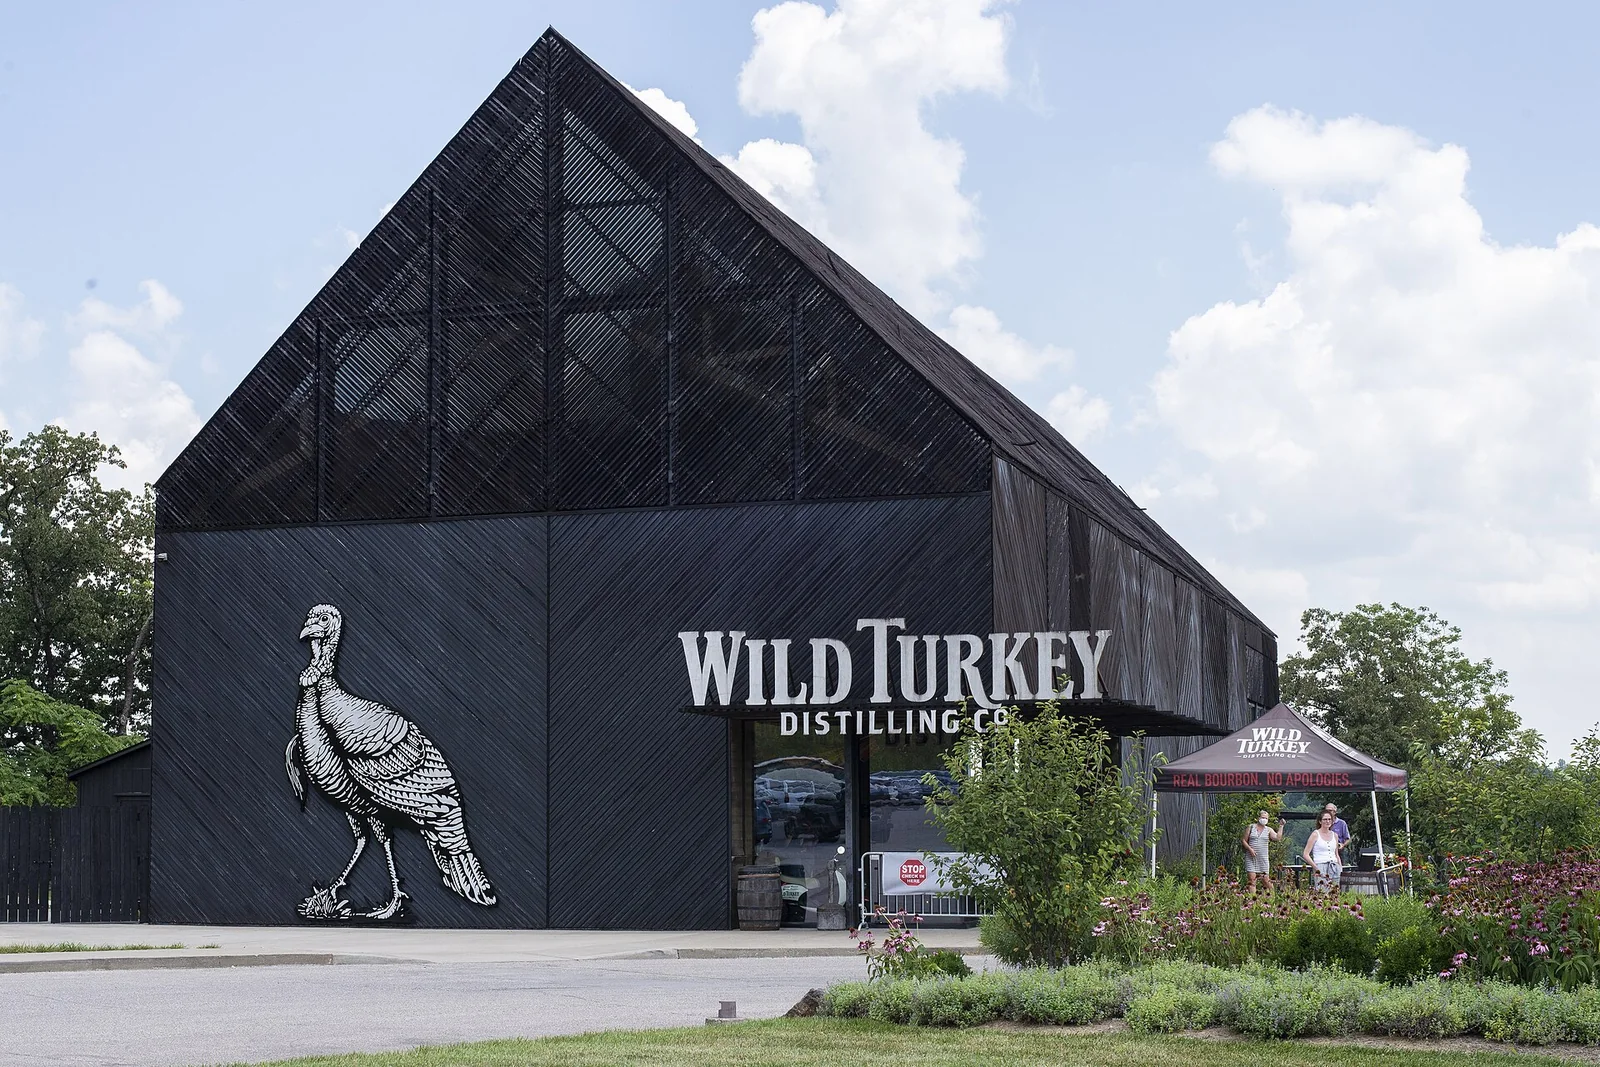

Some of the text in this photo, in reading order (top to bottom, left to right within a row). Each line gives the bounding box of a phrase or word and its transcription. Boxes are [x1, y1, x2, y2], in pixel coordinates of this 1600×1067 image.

[677, 617, 1113, 710] WILD TURKEY
[780, 709, 960, 736] DISTILLING
[1251, 726, 1302, 742] WILD
[1236, 738, 1312, 754] TURKEY
[1172, 772, 1353, 788] REAL BOURBON. NO APOLOGIES.
[901, 864, 925, 874] STOP
